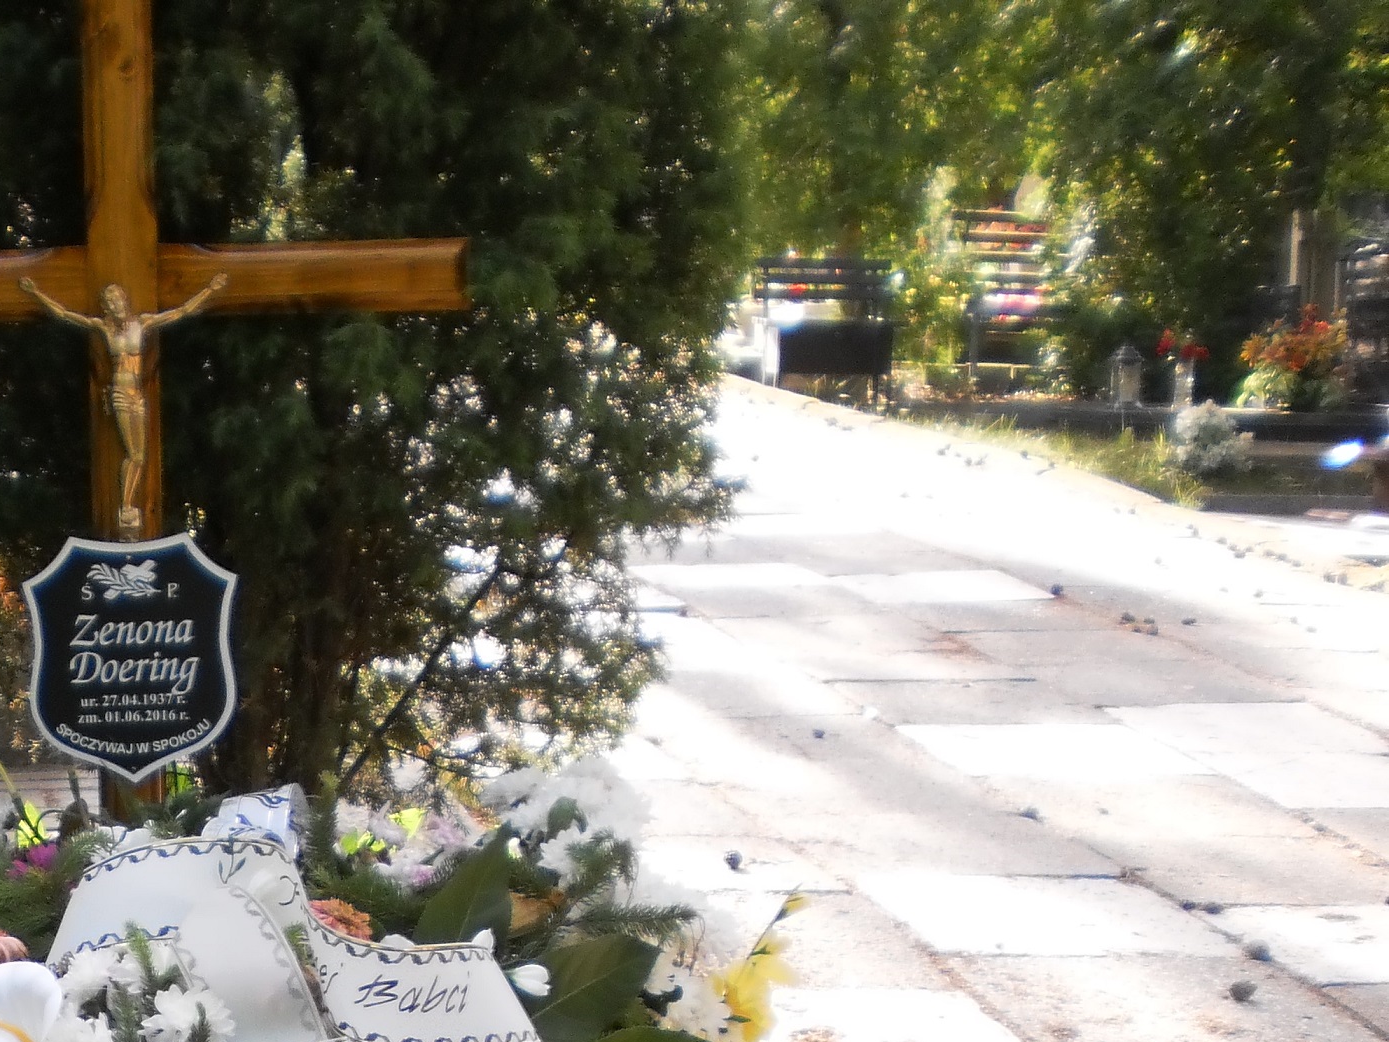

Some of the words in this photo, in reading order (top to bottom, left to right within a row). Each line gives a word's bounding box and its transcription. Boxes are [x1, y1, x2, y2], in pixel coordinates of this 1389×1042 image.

[69, 613, 196, 647] Zenona
[69, 651, 200, 696] Doering
[78, 713, 103, 724] zm.
[104, 710, 176, 723] 01.06.2016
[80, 697, 99, 707] ur.
[101, 694, 174, 707] 27.04.1937
[56, 723, 134, 755] SPOCZYWAJ
[136, 742, 149, 753] W
[152, 718, 212, 752] SPOKOJU
[354, 971, 469, 1013] Babci
